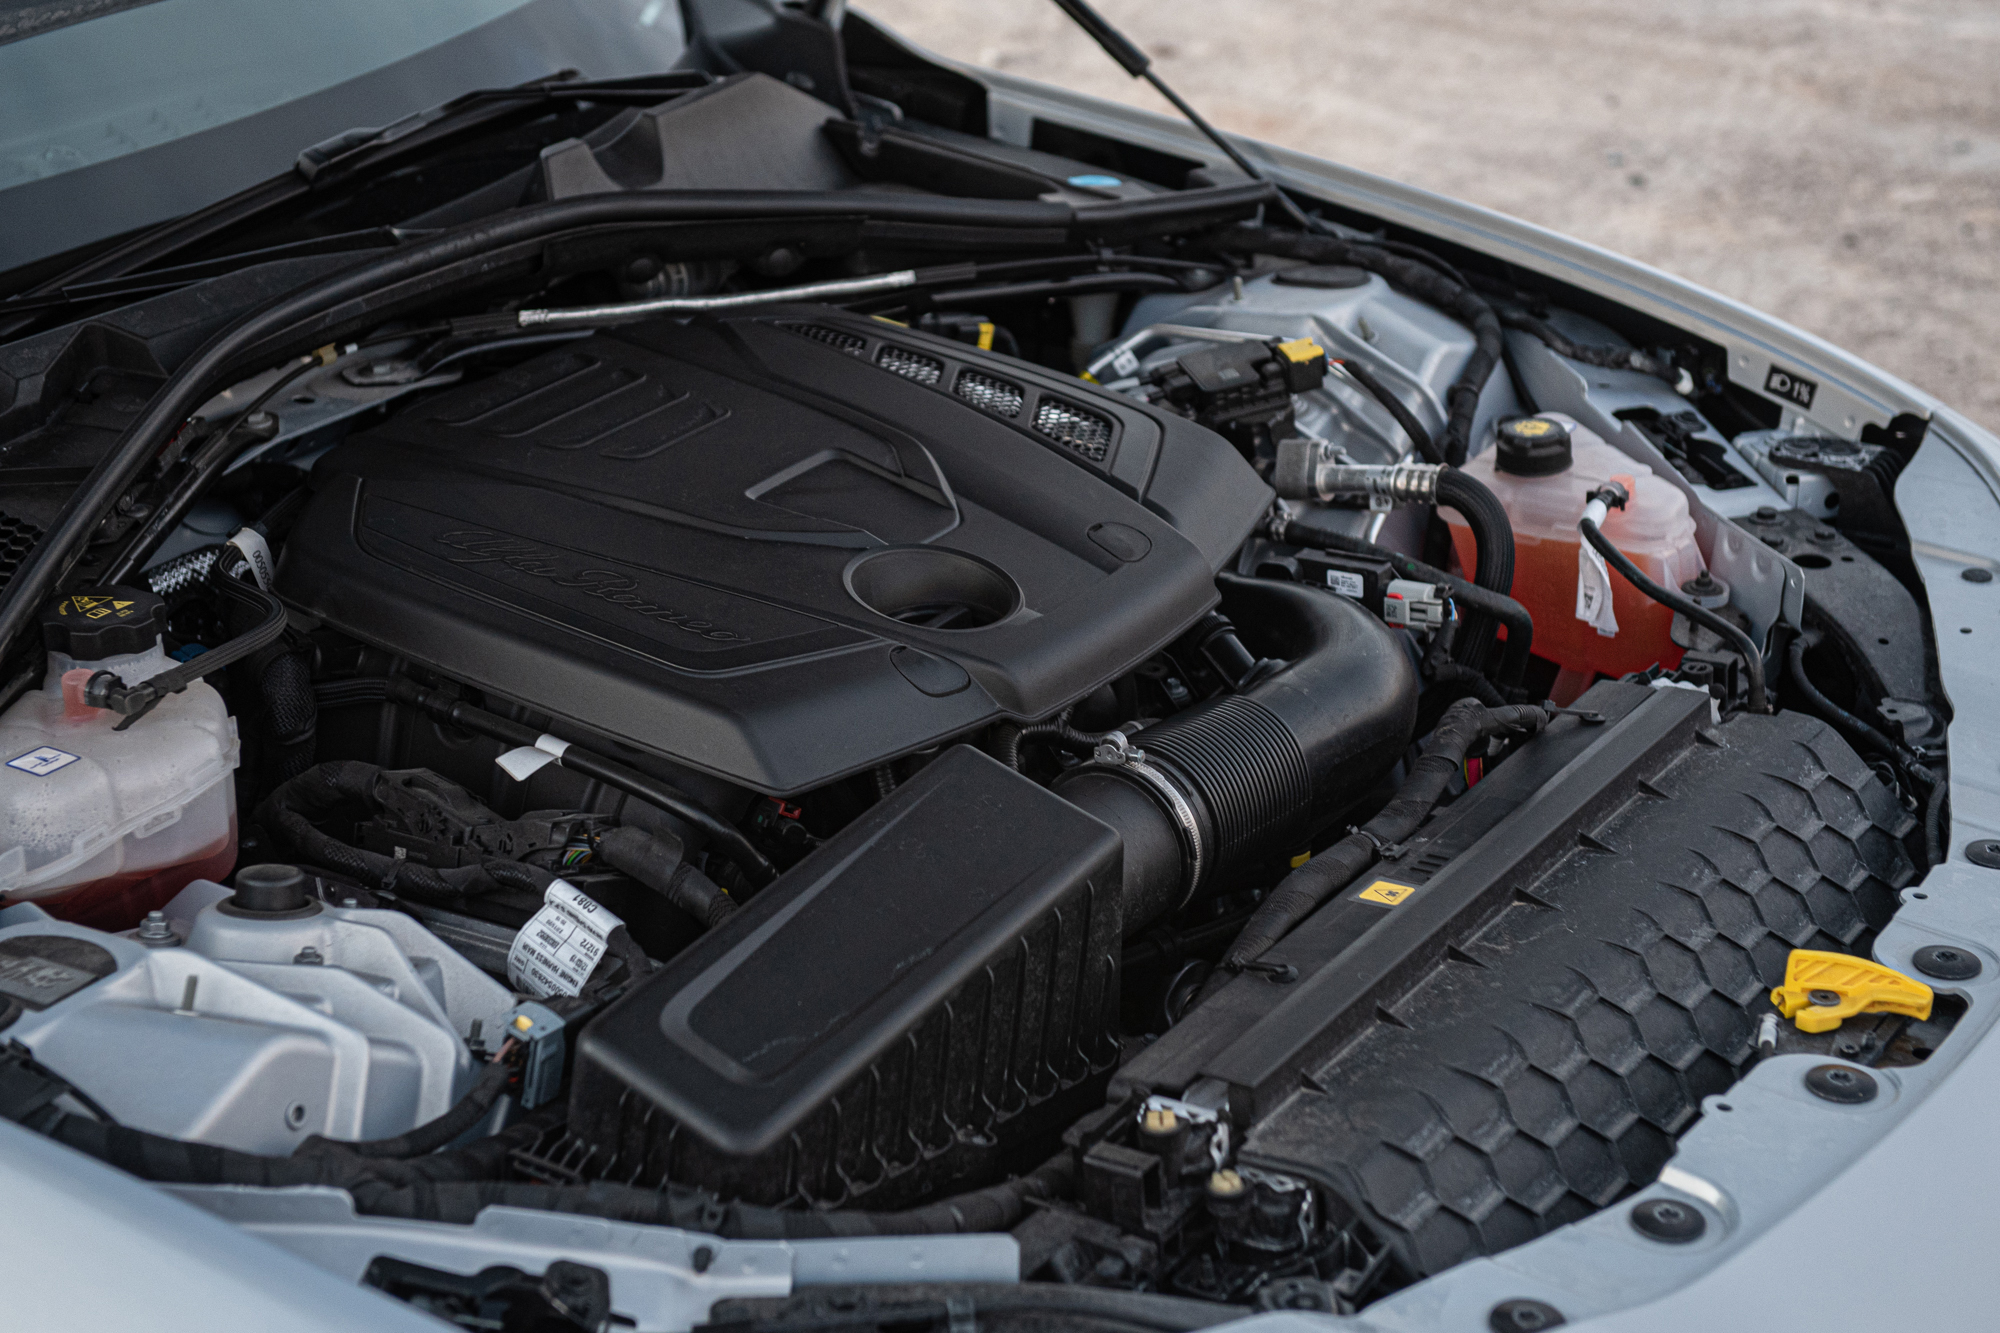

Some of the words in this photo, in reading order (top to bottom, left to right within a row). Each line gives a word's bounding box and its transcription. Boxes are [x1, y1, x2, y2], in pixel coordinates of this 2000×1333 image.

[434, 531, 557, 576] Alfa
[556, 570, 751, 641] Romeo
[573, 894, 598, 914] C081
[580, 938, 600, 957] 91272
[535, 952, 560, 974] HARNESS
[558, 969, 579, 988] ENGINE
